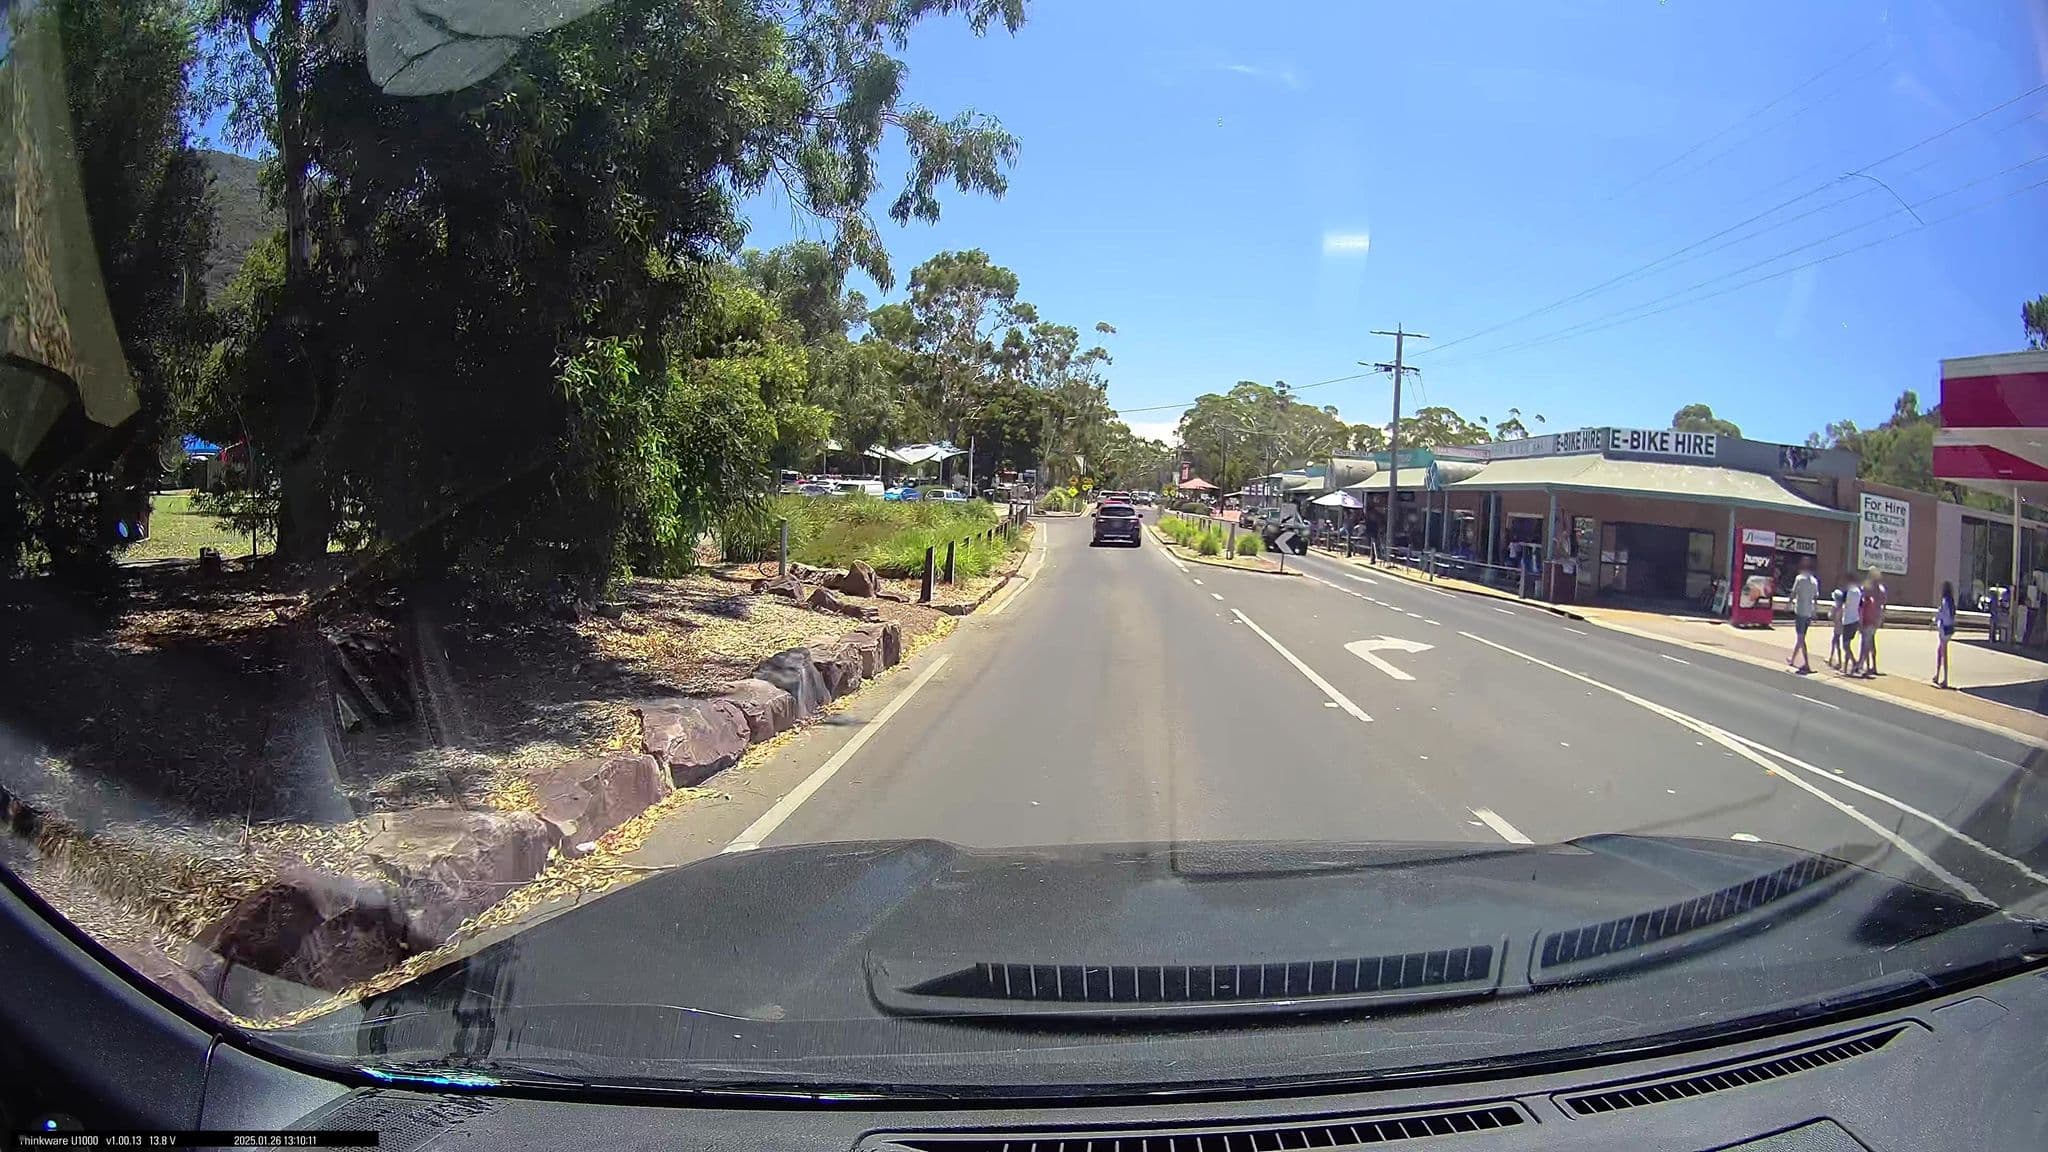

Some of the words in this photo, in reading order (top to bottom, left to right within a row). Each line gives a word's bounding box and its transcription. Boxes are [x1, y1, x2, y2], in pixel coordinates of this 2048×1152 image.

[1556, 433, 1581, 452] E-BIKE
[1582, 431, 1601, 449] HIRE
[1610, 430, 1669, 451] E-BIKE
[1675, 434, 1715, 457] HIRE
[1864, 497, 1881, 510] For
[1885, 502, 1906, 516] Hire
[1744, 553, 1770, 567] hungry
